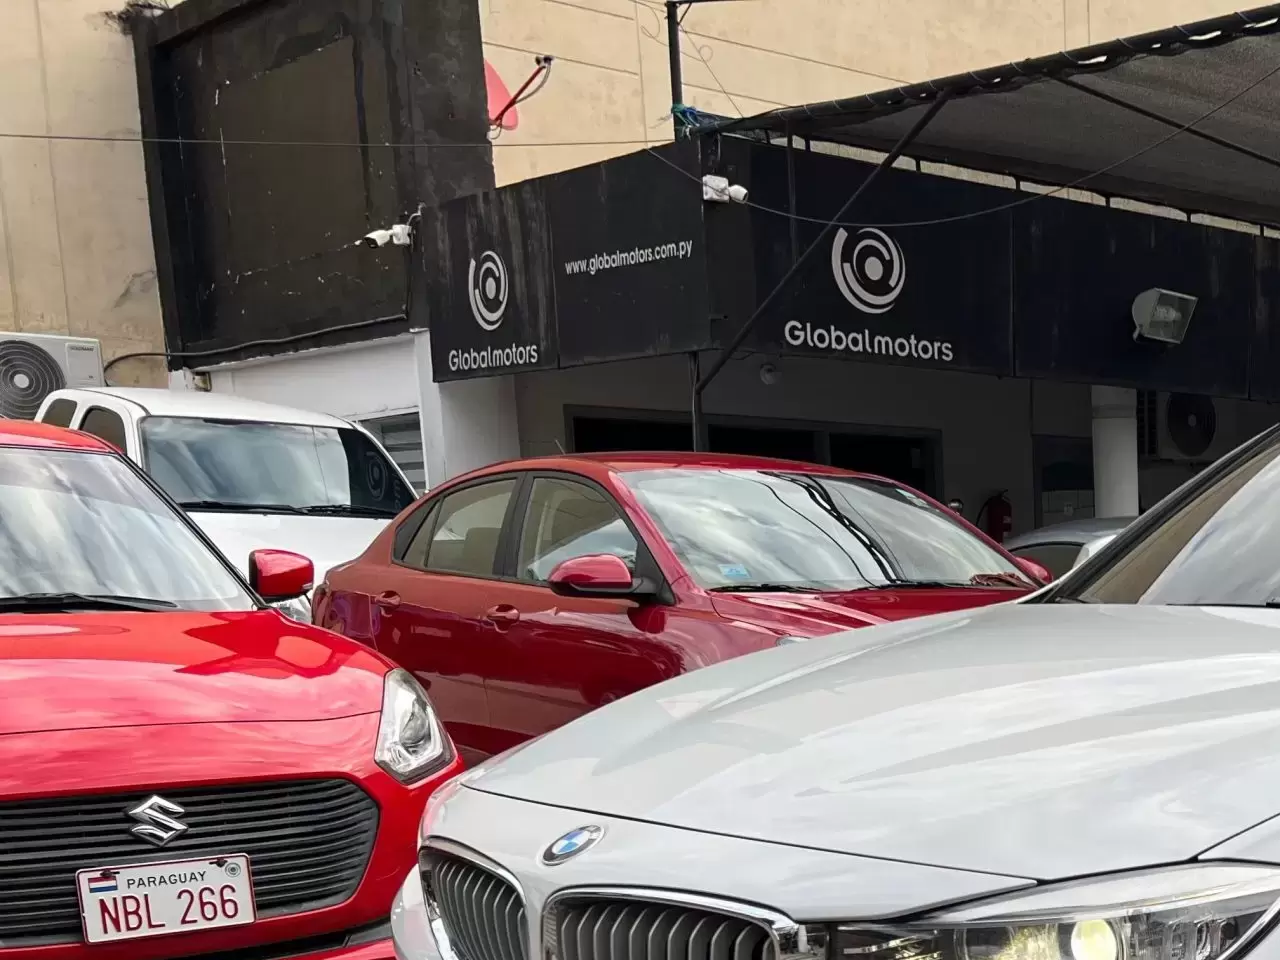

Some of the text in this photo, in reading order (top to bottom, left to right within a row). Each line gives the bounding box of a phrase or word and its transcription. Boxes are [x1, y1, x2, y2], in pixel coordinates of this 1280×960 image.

[565, 240, 692, 275] www.globalmotors.com.py
[448, 342, 538, 371] Globalmotors
[784, 320, 953, 361] Globalmotors
[126, 871, 206, 889] PARAGUAY
[99, 884, 239, 934] NBL 266
